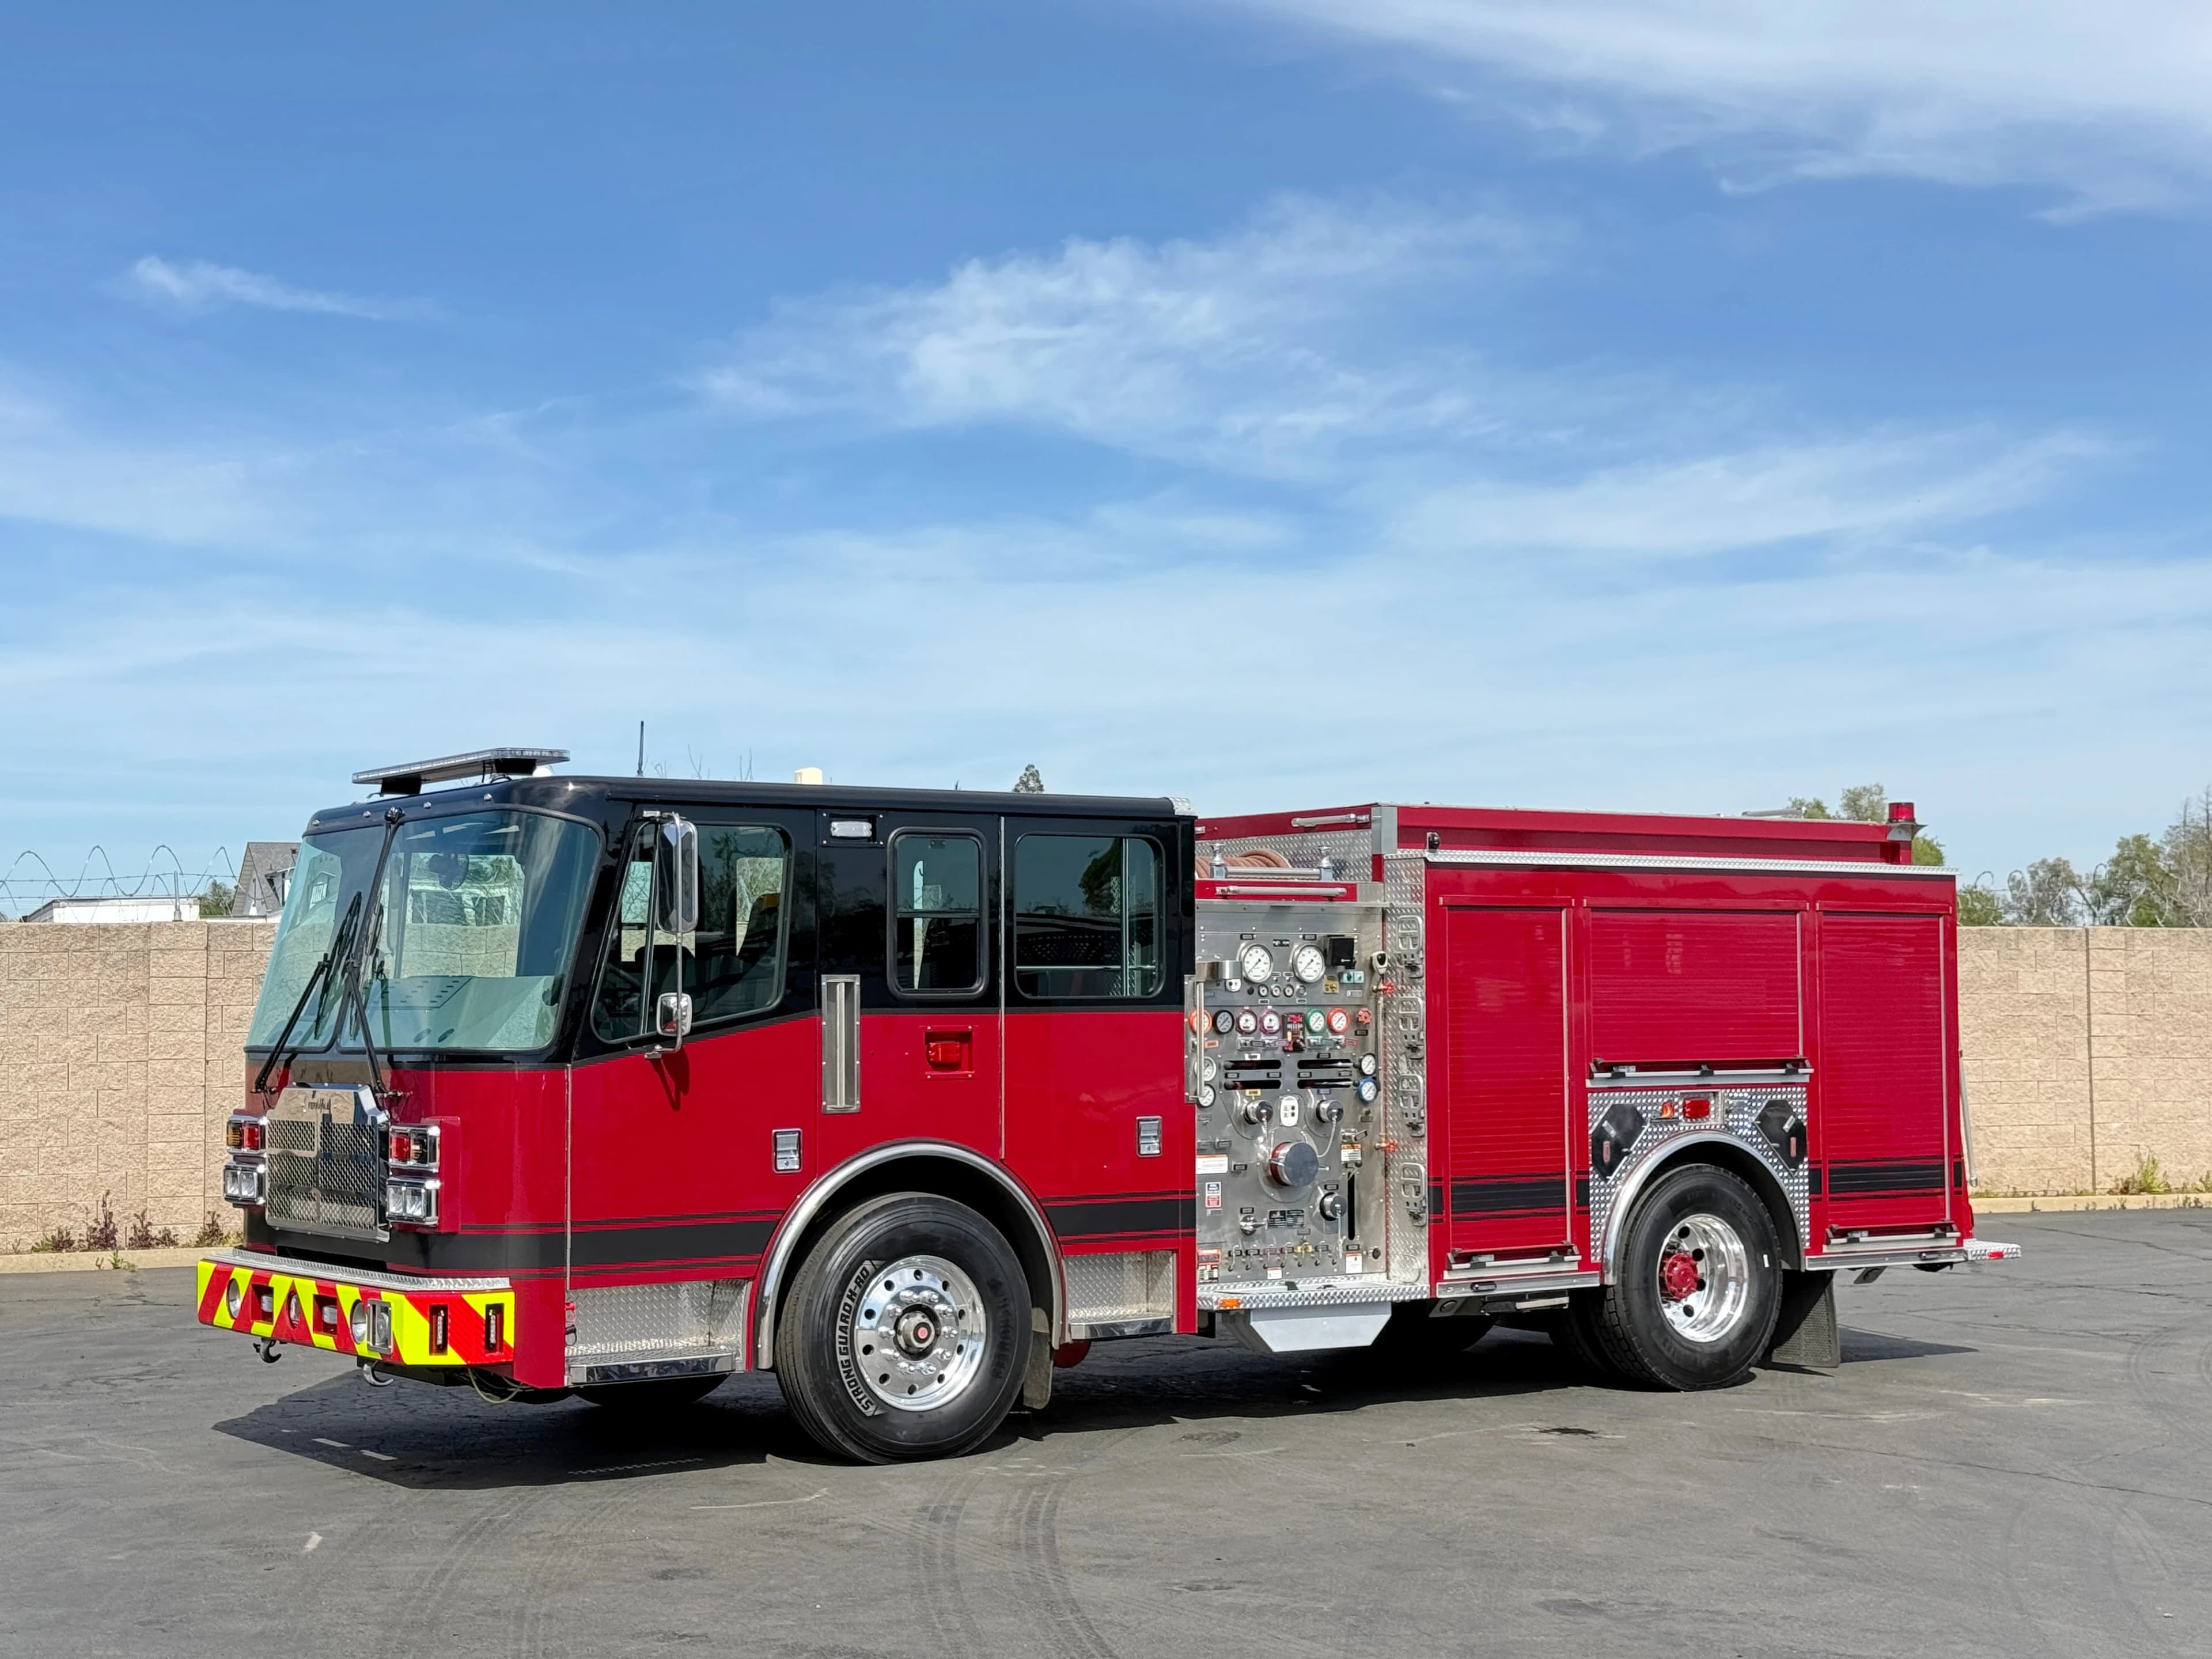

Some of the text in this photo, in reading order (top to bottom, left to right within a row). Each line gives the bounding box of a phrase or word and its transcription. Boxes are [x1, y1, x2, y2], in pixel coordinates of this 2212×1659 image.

[838, 1266, 873, 1411] STRONG GUARD H-RD
